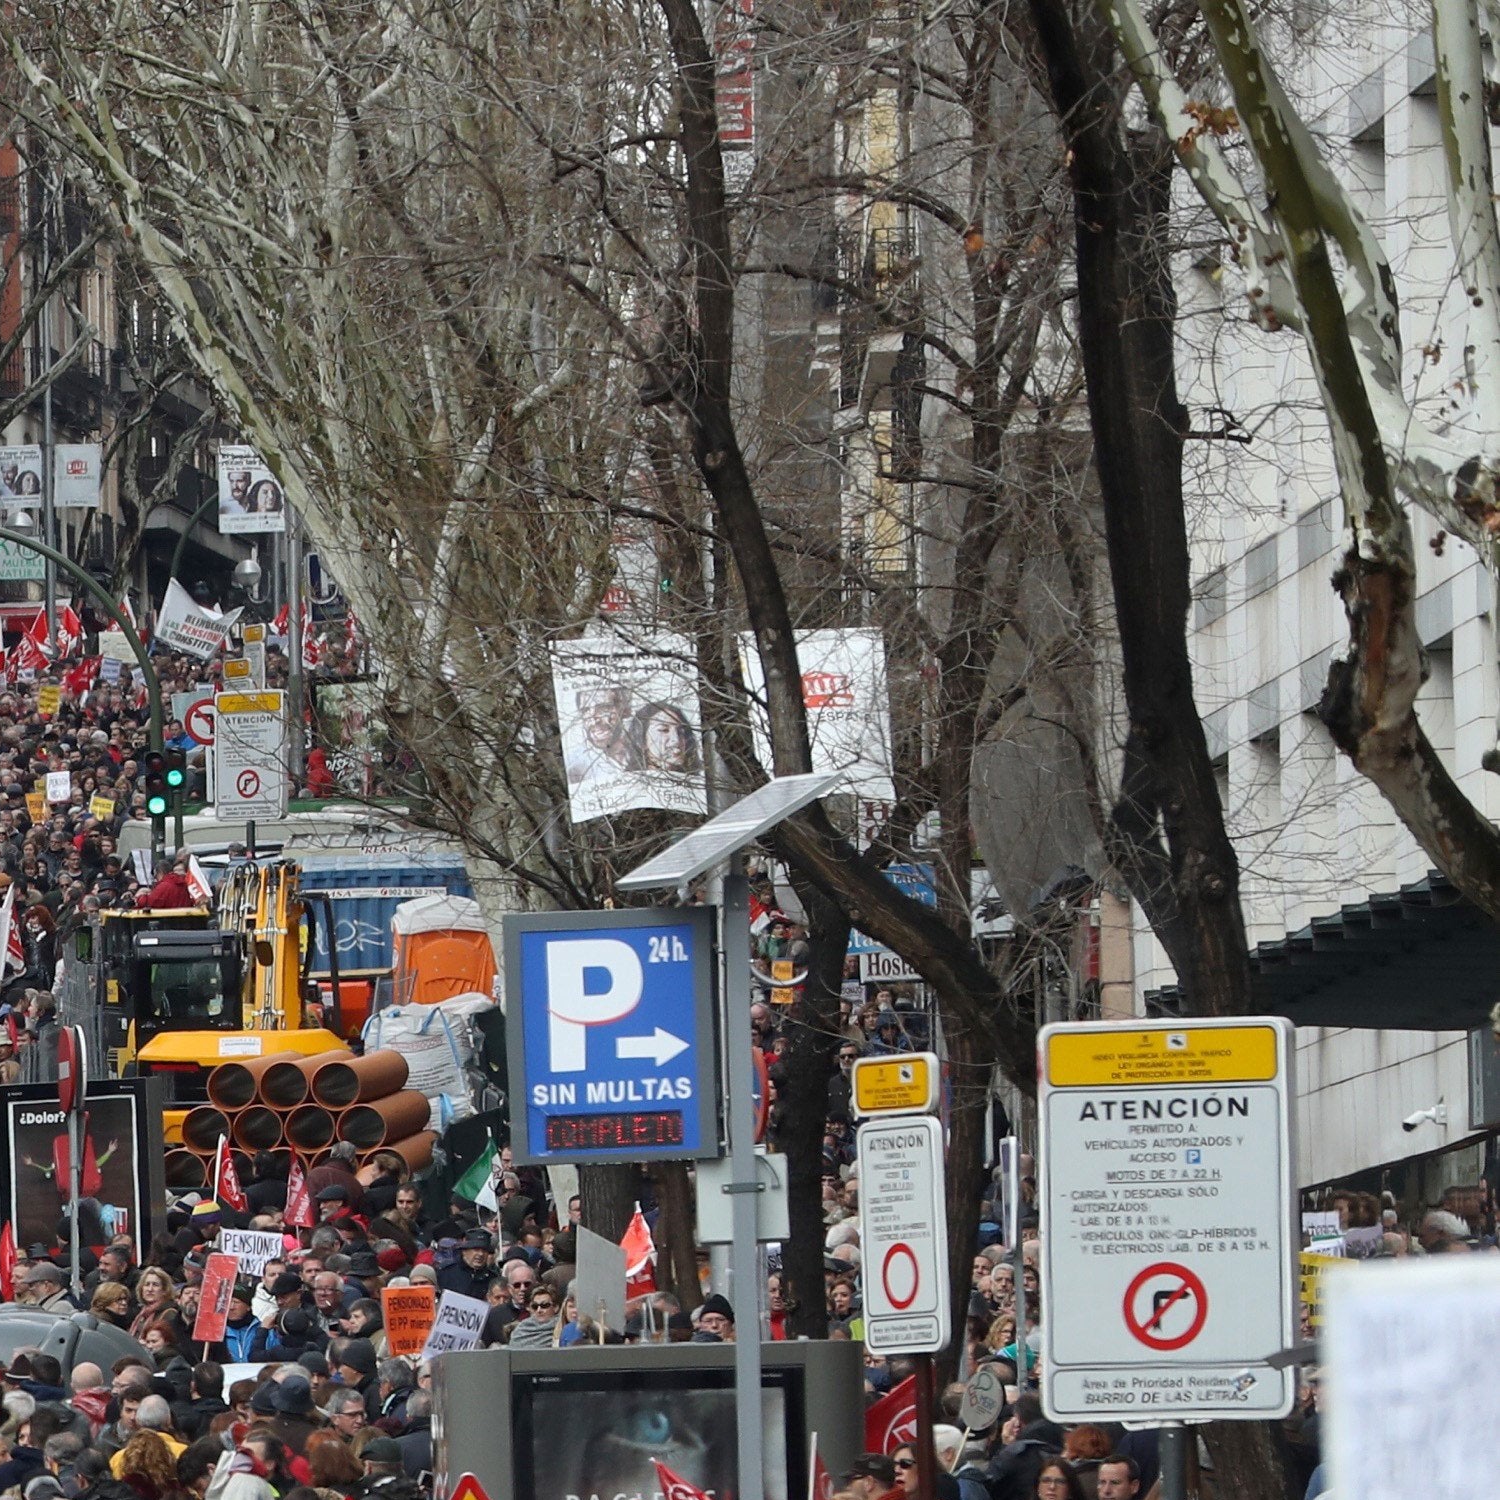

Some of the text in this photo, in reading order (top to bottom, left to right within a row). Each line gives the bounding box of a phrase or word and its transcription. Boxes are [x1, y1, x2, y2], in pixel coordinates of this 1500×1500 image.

[546, 935, 689, 1073] P 24 h.
[533, 1076, 693, 1106] SIN MULTAS
[1078, 1093, 1250, 1121] ATENCIÓN
[19, 1110, 67, 1125] ¿Dolor?
[547, 1115, 684, 1148] COMPLETO
[1128, 1124, 1184, 1135] PERMITIDO
[1152, 1136, 1232, 1149] AUTORIZADOS
[1236, 1135, 1244, 1146] Y
[1128, 1151, 1177, 1163] ACCESO
[1106, 1170, 1146, 1181] MOTOS
[1151, 1170, 1166, 1180] DE
[1181, 1169, 1189, 1179] A
[1193, 1169, 1208, 1179] 22
[1070, 1185, 1219, 1200] CARGA Y DESCARGA SÓLO
[1105, 1215, 1122, 1226] DE
[223, 1232, 283, 1259] PENSIONES
[1198, 1242, 1214, 1253] DE
[1230, 1241, 1240, 1252] A
[1132, 1377, 1185, 1389] Prioridad
[1085, 1389, 1250, 1405] BARRIO DE LAS LETRAS
